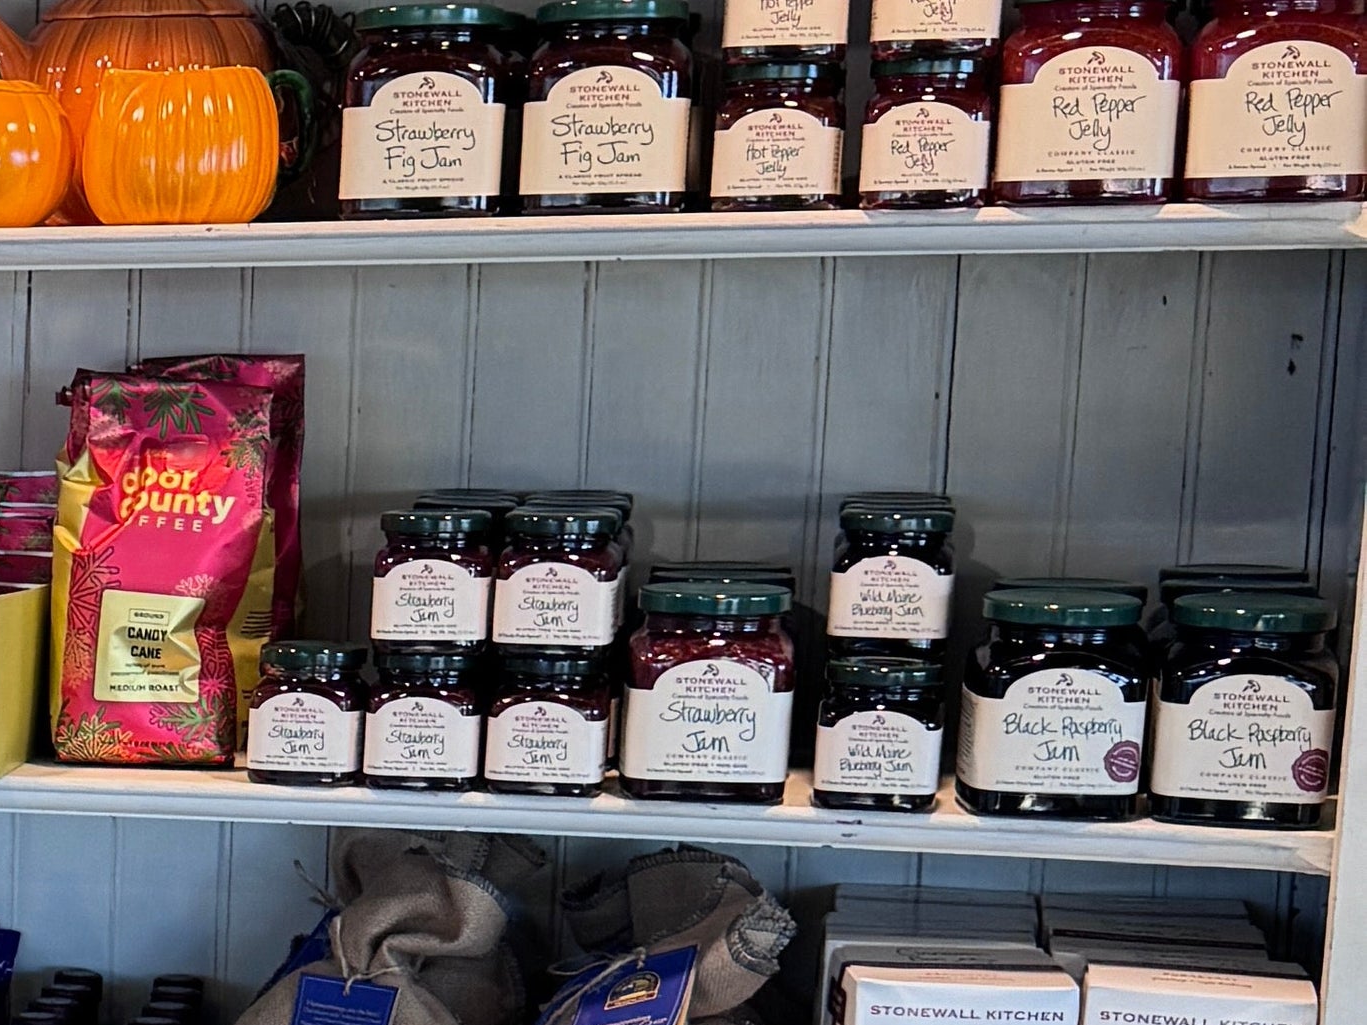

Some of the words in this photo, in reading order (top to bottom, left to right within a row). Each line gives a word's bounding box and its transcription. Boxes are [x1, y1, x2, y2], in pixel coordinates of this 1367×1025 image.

[1057, 65, 1136, 76] STONEWALL
[1251, 59, 1332, 71] STONEWALL
[1261, 69, 1320, 79] KITCHEN
[1052, 94, 1081, 118] Red
[1093, 92, 1147, 119] Pepper
[1244, 91, 1278, 114] Red
[1286, 88, 1343, 115] Pepper
[375, 118, 476, 151] Strawberry
[550, 113, 655, 146] Strawberry
[1068, 117, 1113, 151] Jelly
[1261, 113, 1307, 148] Jelly
[561, 141, 592, 173] Fig
[596, 140, 641, 166] Jam
[745, 143, 769, 162] Hot
[890, 140, 911, 156] Red
[917, 138, 957, 155] Pepper
[385, 145, 416, 177] Fig
[420, 146, 462, 170] Jam
[755, 159, 788, 178] Jelly
[127, 626, 168, 643] CANDY
[130, 645, 163, 660] CANE
[148, 684, 180, 692] ROAST
[1213, 691, 1291, 704] STONEWALL
[1222, 701, 1279, 712] KITCHEN
[658, 700, 758, 742] Strawberry
[1002, 712, 1060, 738] Black
[1062, 715, 1123, 745] Raspberry
[681, 730, 731, 753] Jam
[1187, 718, 1245, 743] Black
[1248, 720, 1313, 753] Raspberry
[1033, 739, 1080, 763] Jam
[1218, 745, 1268, 771] Jam
[869, 1003, 981, 1021] STONEWALL
[985, 1008, 1065, 1024] KITCHEN
